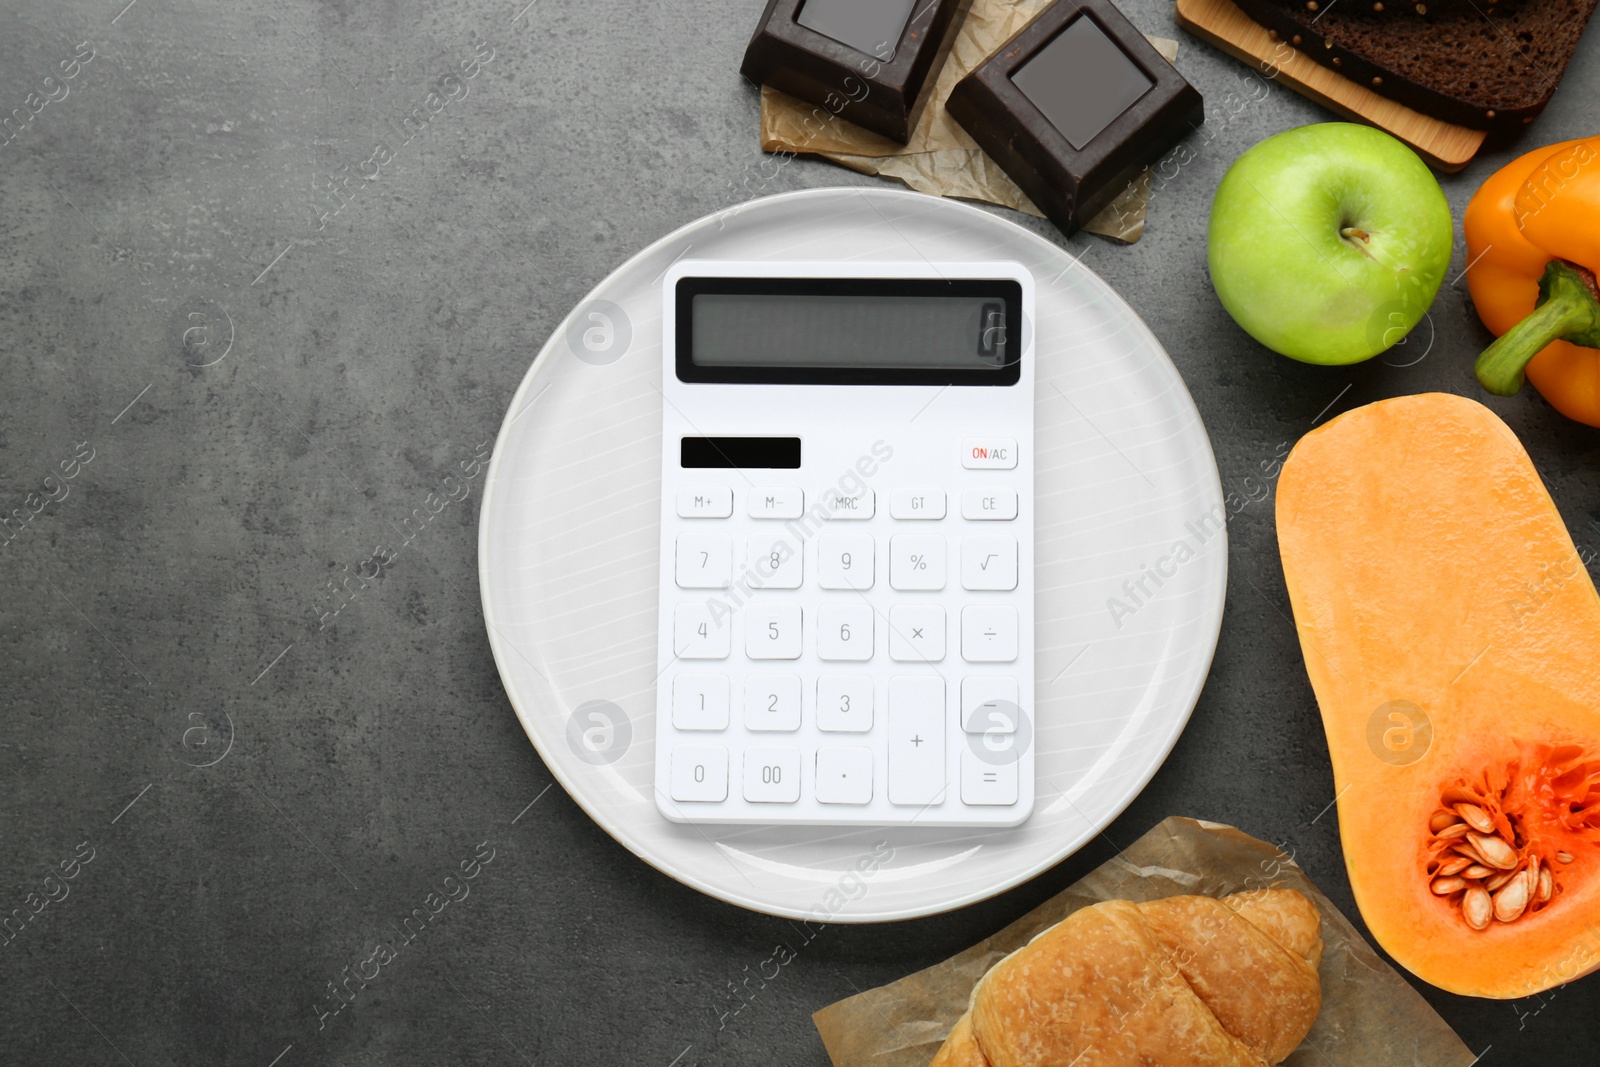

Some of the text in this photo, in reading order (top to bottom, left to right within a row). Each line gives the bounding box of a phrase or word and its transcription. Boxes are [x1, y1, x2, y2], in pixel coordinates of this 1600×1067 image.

[973, 447, 1007, 460] ON/AC
[694, 495, 713, 508] M+
[835, 496, 858, 510] MRC
[911, 496, 925, 510] GT
[982, 497, 996, 511] CE
[700, 551, 709, 569] 7
[769, 551, 780, 570] 8
[841, 552, 852, 570] 9
[910, 554, 927, 571] %
[697, 622, 708, 639] 4
[768, 622, 779, 640] 5
[840, 623, 851, 641] 6
[699, 693, 705, 711] 1
[768, 694, 778, 712] 2
[840, 694, 851, 713] 3
[694, 764, 705, 784] 0
[762, 765, 782, 785] 00
